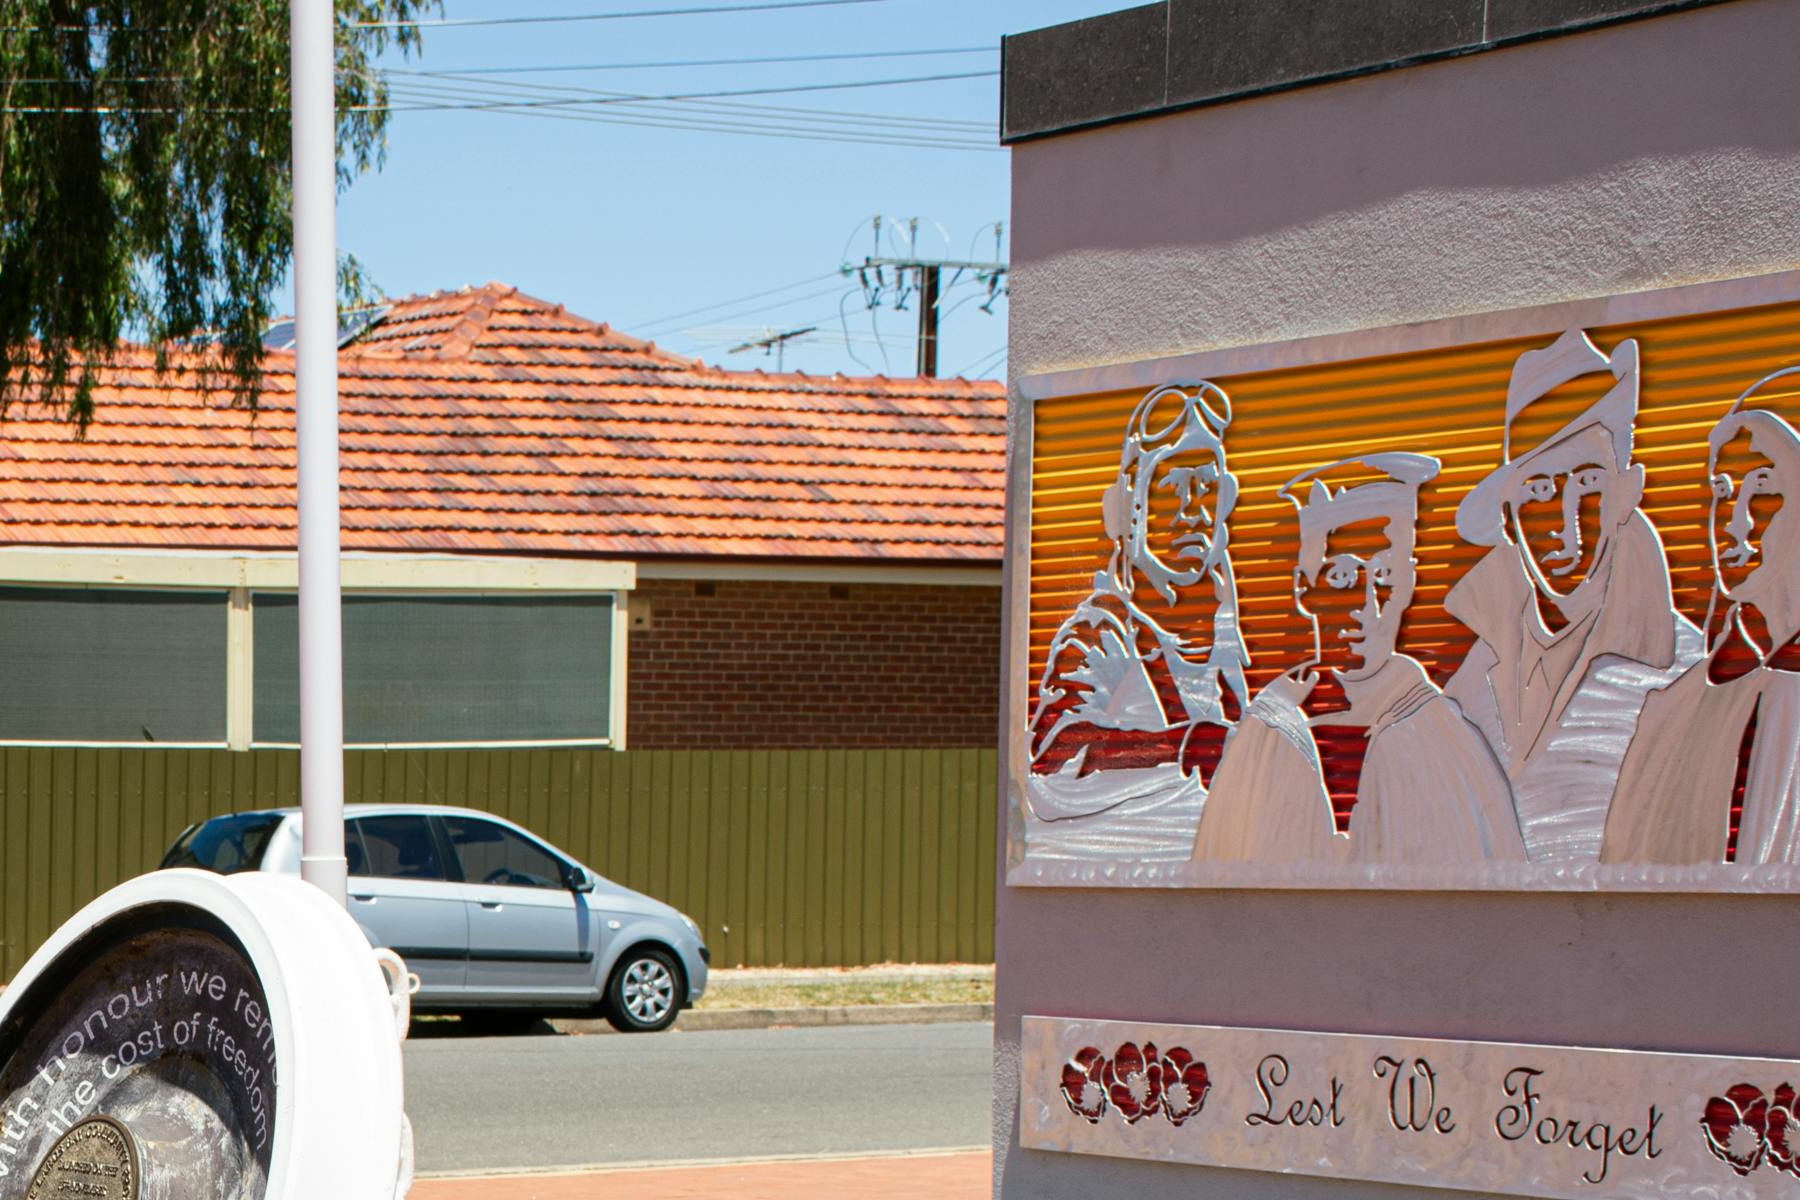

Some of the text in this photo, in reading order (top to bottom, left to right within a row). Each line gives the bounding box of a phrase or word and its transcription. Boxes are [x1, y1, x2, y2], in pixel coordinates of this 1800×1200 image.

[36, 972, 168, 1086] honour
[180, 970, 227, 1001] we
[45, 1012, 268, 1150] the cost of freedom
[1244, 1053, 1663, 1185] Lest We Forget
